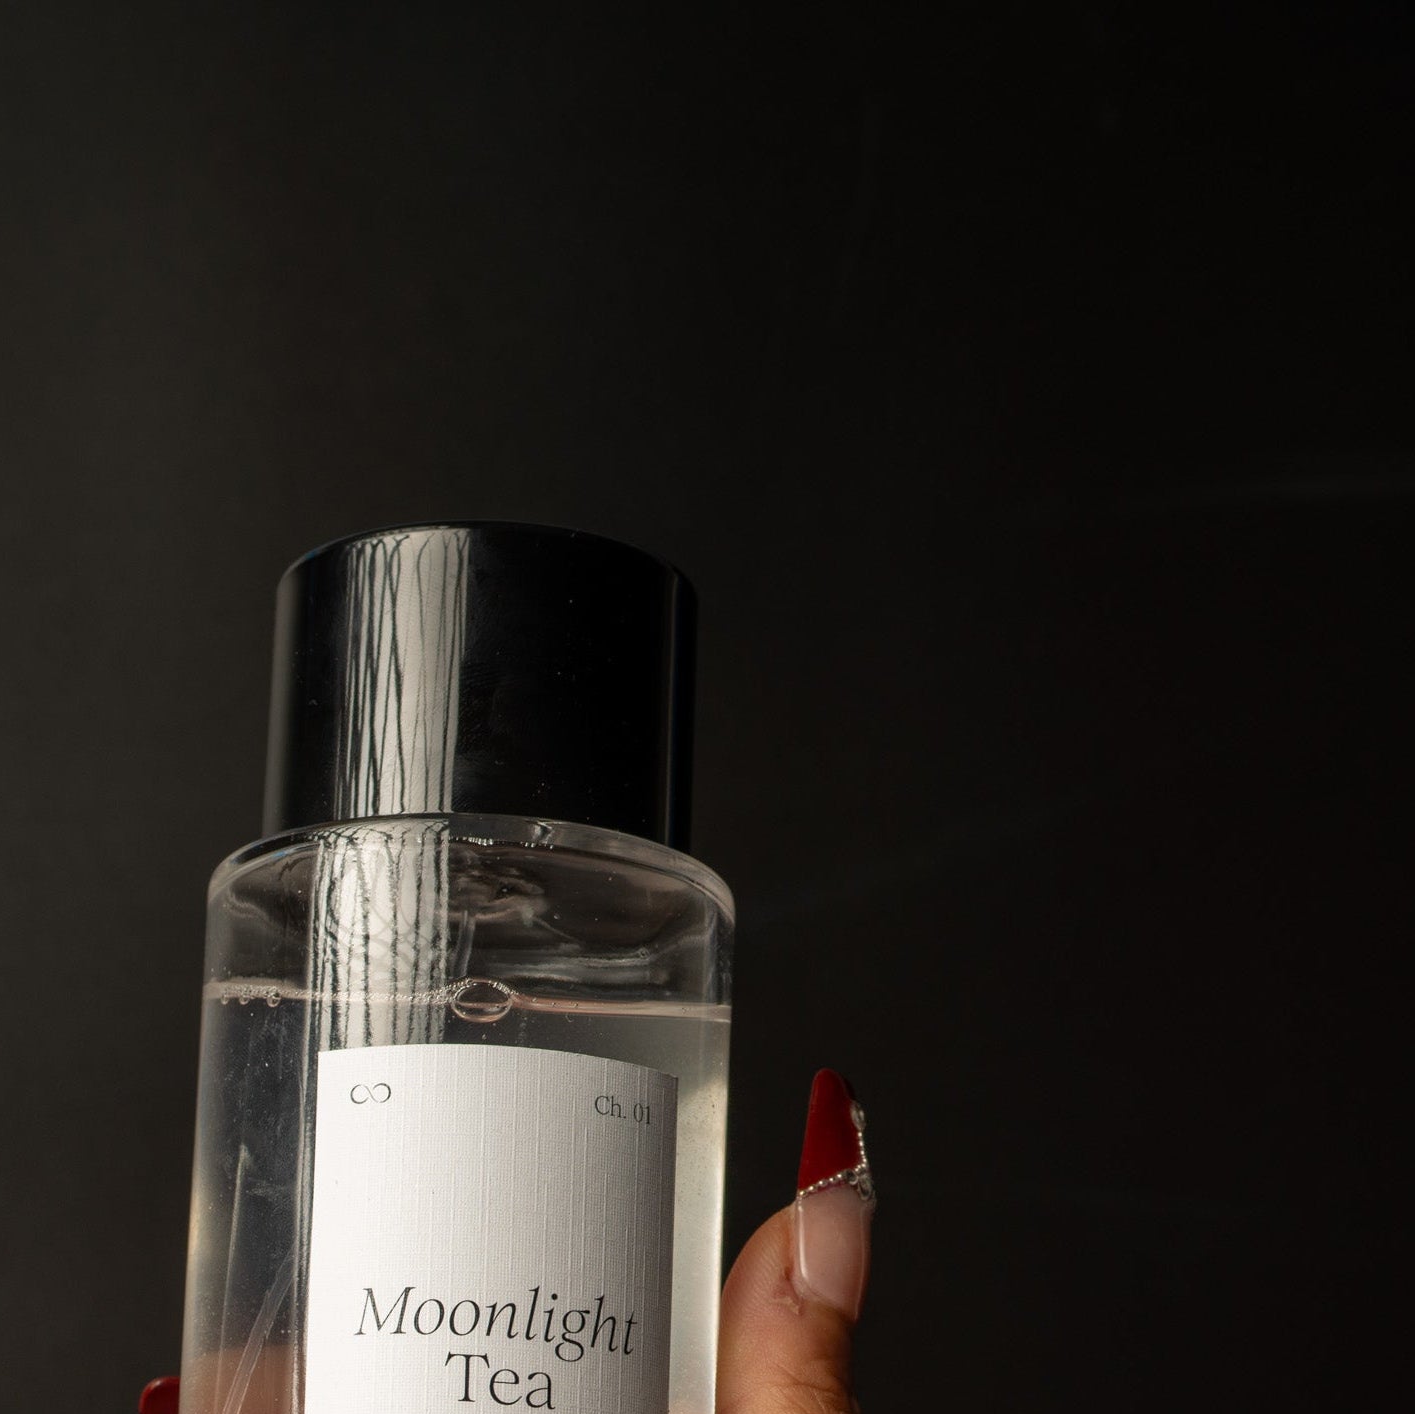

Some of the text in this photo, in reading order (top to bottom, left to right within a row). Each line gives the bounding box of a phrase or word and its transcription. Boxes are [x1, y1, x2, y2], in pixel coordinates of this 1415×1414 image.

[594, 1095, 653, 1125] Ch. 01
[354, 1285, 638, 1363] Moonlight
[444, 1351, 556, 1410] Tea
